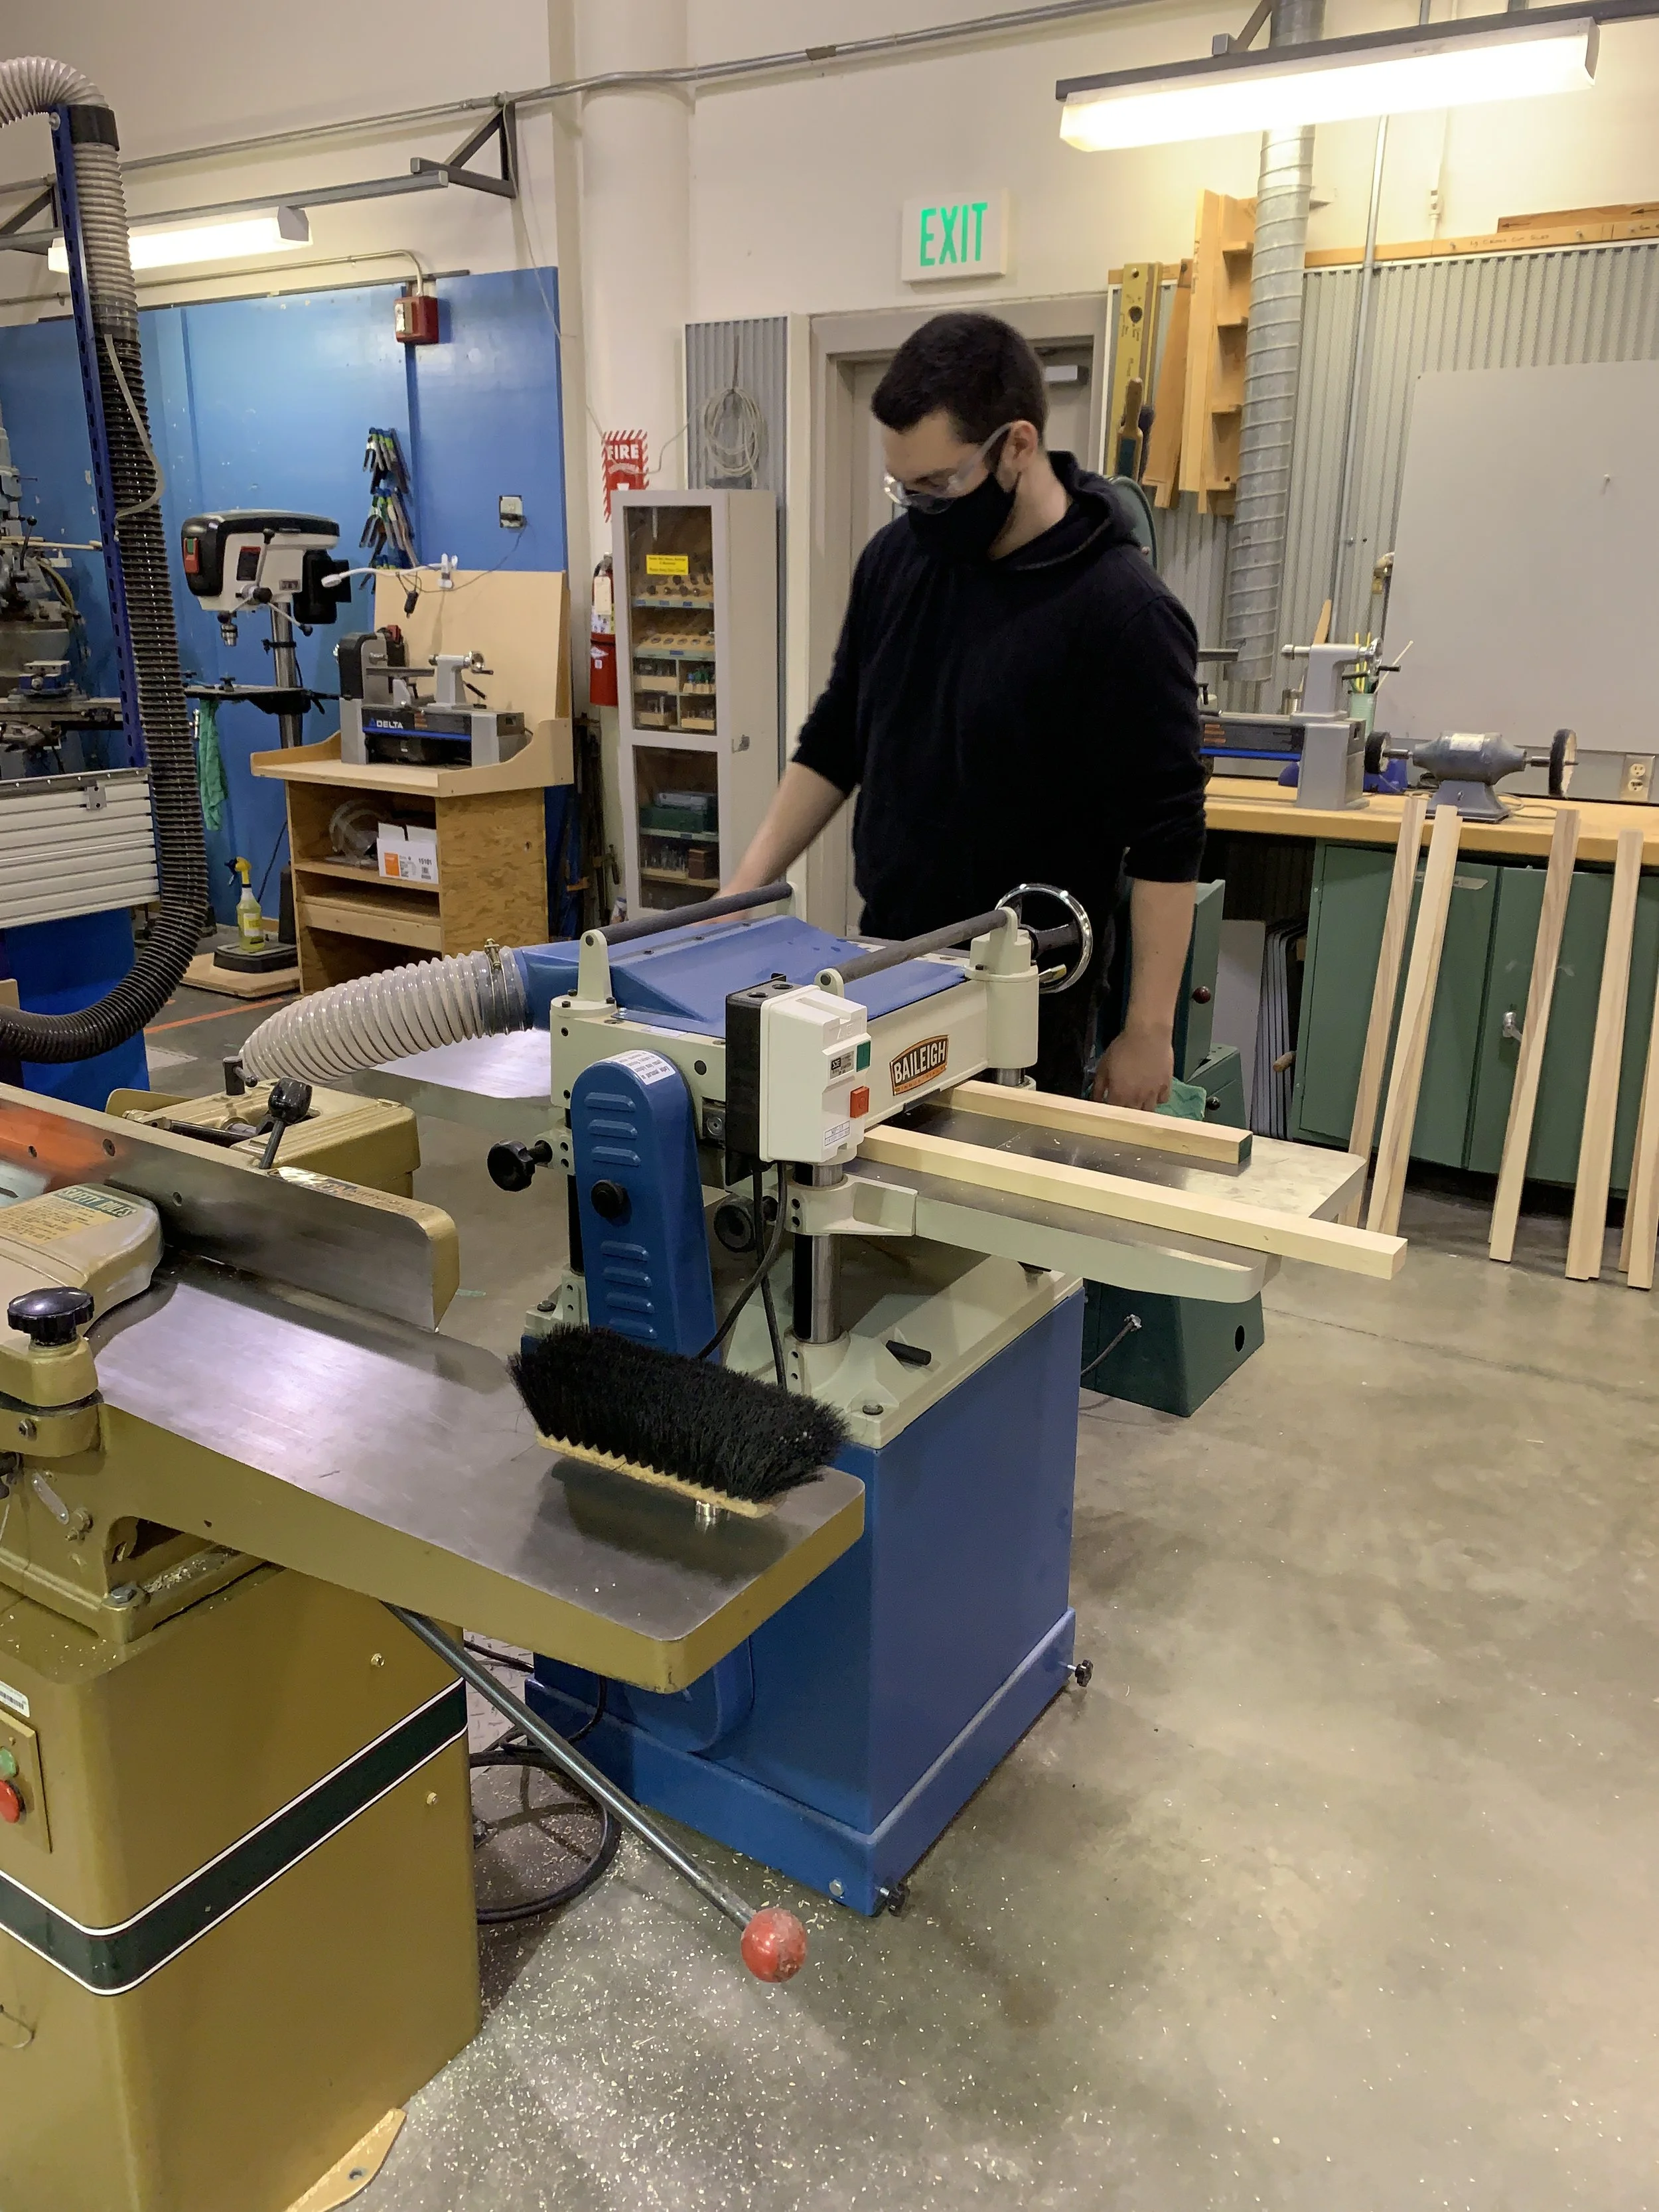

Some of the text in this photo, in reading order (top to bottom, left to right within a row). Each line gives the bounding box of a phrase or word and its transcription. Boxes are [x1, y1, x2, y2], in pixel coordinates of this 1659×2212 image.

[920, 202, 988, 267] EXIT
[607, 444, 640, 461] FIRE
[376, 720, 403, 729] DELTA
[894, 1041, 946, 1084] BAILEIGH
